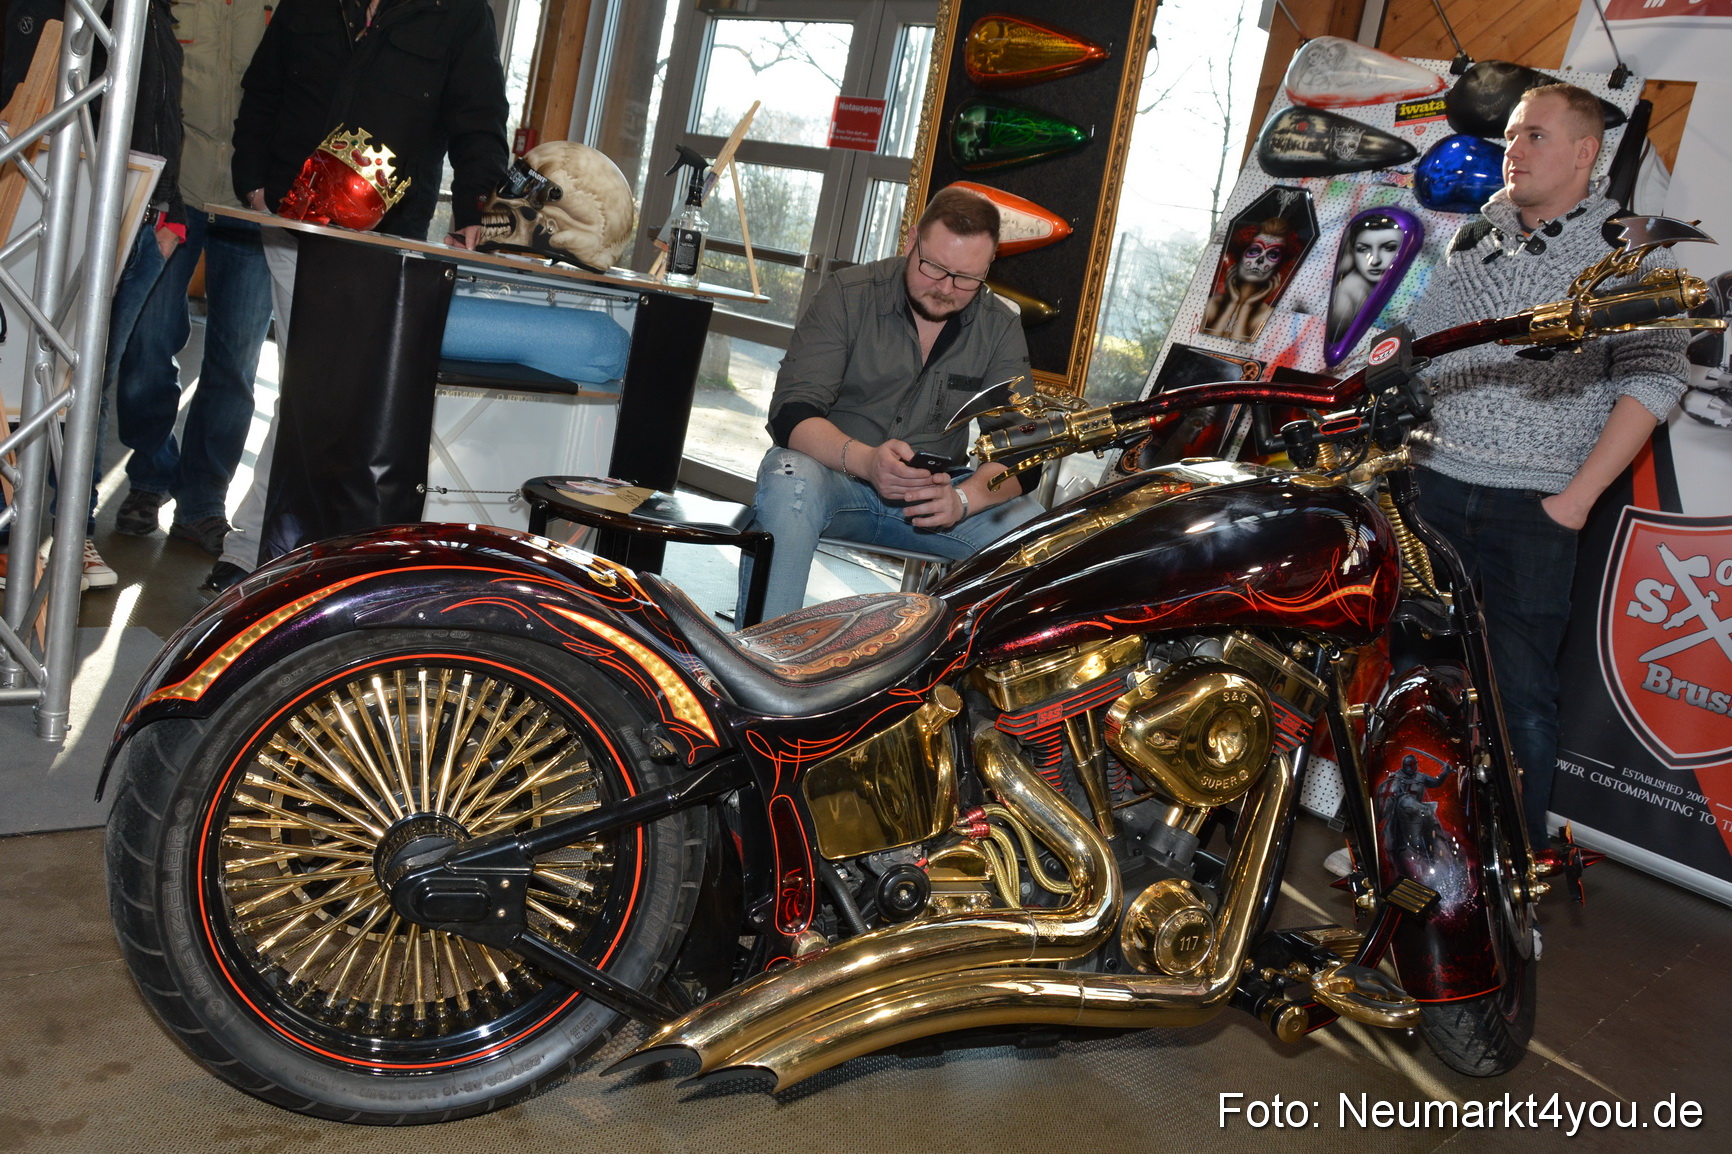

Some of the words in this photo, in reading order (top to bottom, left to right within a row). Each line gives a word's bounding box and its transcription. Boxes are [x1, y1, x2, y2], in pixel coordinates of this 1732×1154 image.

[839, 102, 882, 115] Notausgang
[1399, 100, 1446, 116] iwata
[1222, 692, 1248, 703] S&S
[1641, 662, 1732, 718] Brus
[1040, 707, 1062, 723] S&S
[1201, 775, 1238, 790] SUPER
[1622, 767, 1684, 796] ESTABLISHED
[1686, 791, 1710, 806] 2007
[1590, 771, 1694, 817] CUSTOMPAINTING
[1699, 810, 1717, 826] TO
[162, 825, 211, 1000] METZELER
[1180, 935, 1199, 951] 117
